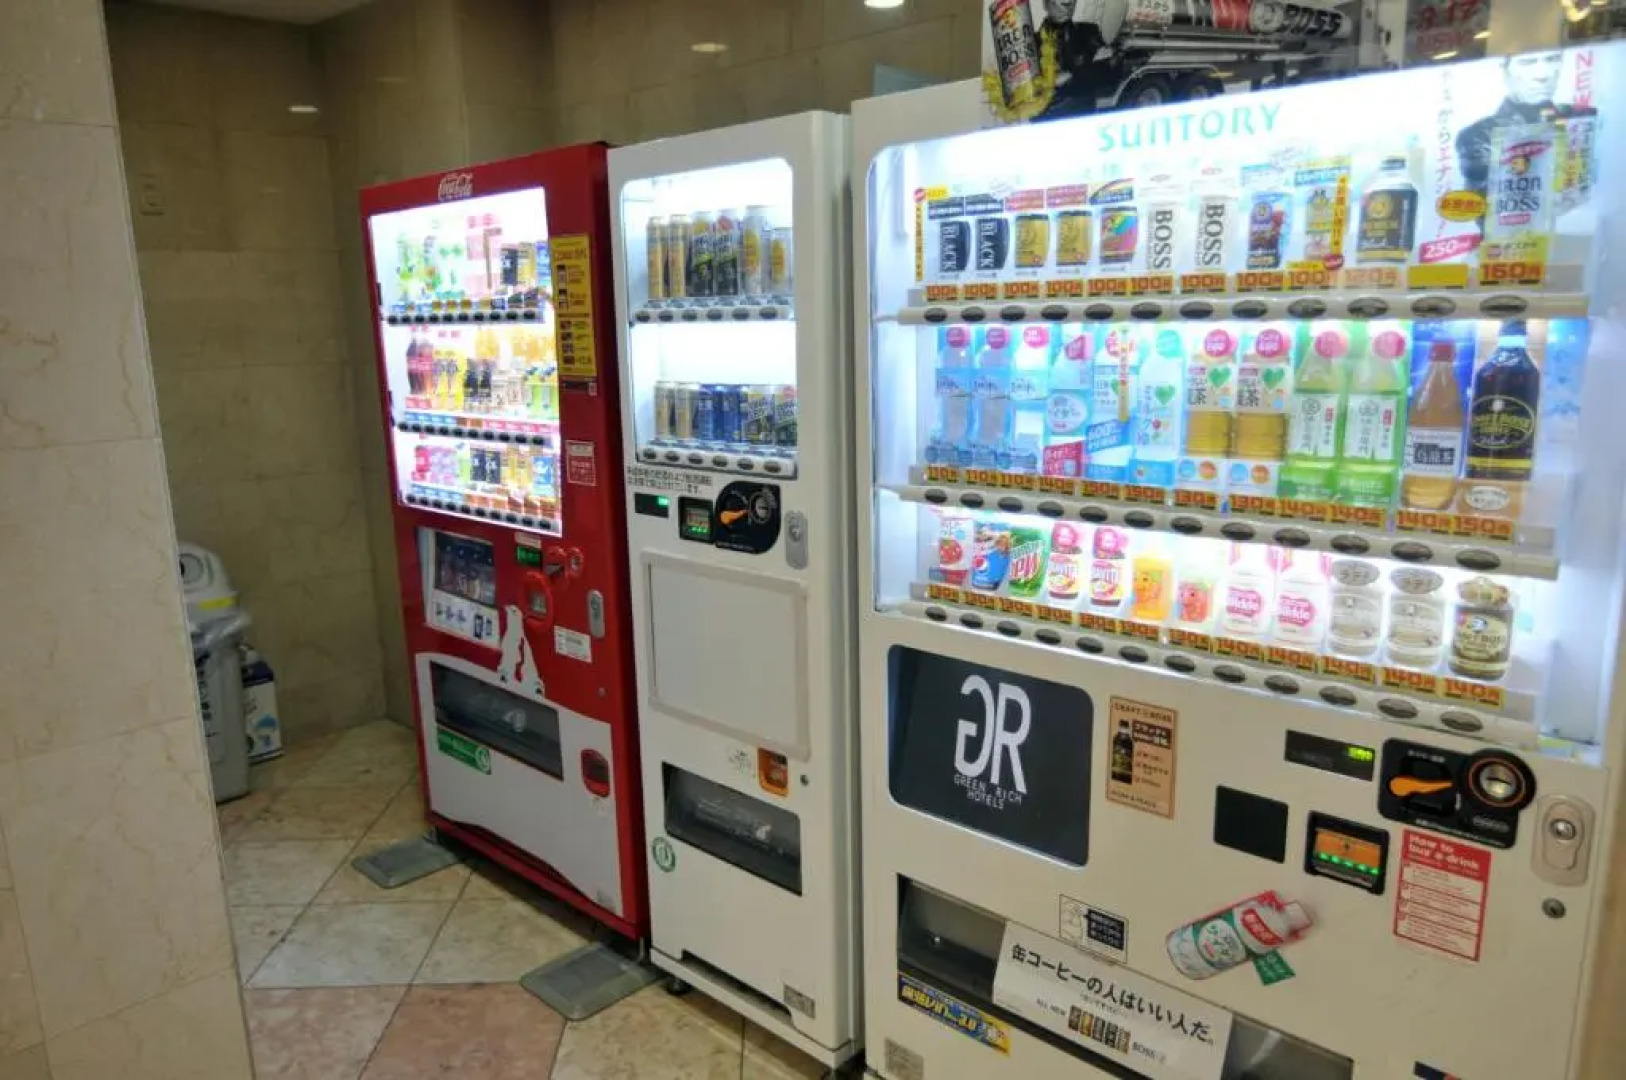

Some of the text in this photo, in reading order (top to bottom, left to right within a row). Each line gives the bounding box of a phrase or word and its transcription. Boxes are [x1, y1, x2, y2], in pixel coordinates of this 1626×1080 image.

[1098, 102, 1281, 151] SUNTORY
[942, 225, 960, 270] BLACK
[979, 220, 997, 268] BLACK
[1152, 208, 1173, 270] BOSS
[1201, 203, 1226, 266] BOSS
[953, 774, 1023, 806] GREEN RICH
[966, 790, 1005, 811] HOTELS
[1446, 853, 1480, 871] drink
[1011, 943, 1215, 1046] 缶コーヒーの人はいい人だ。
